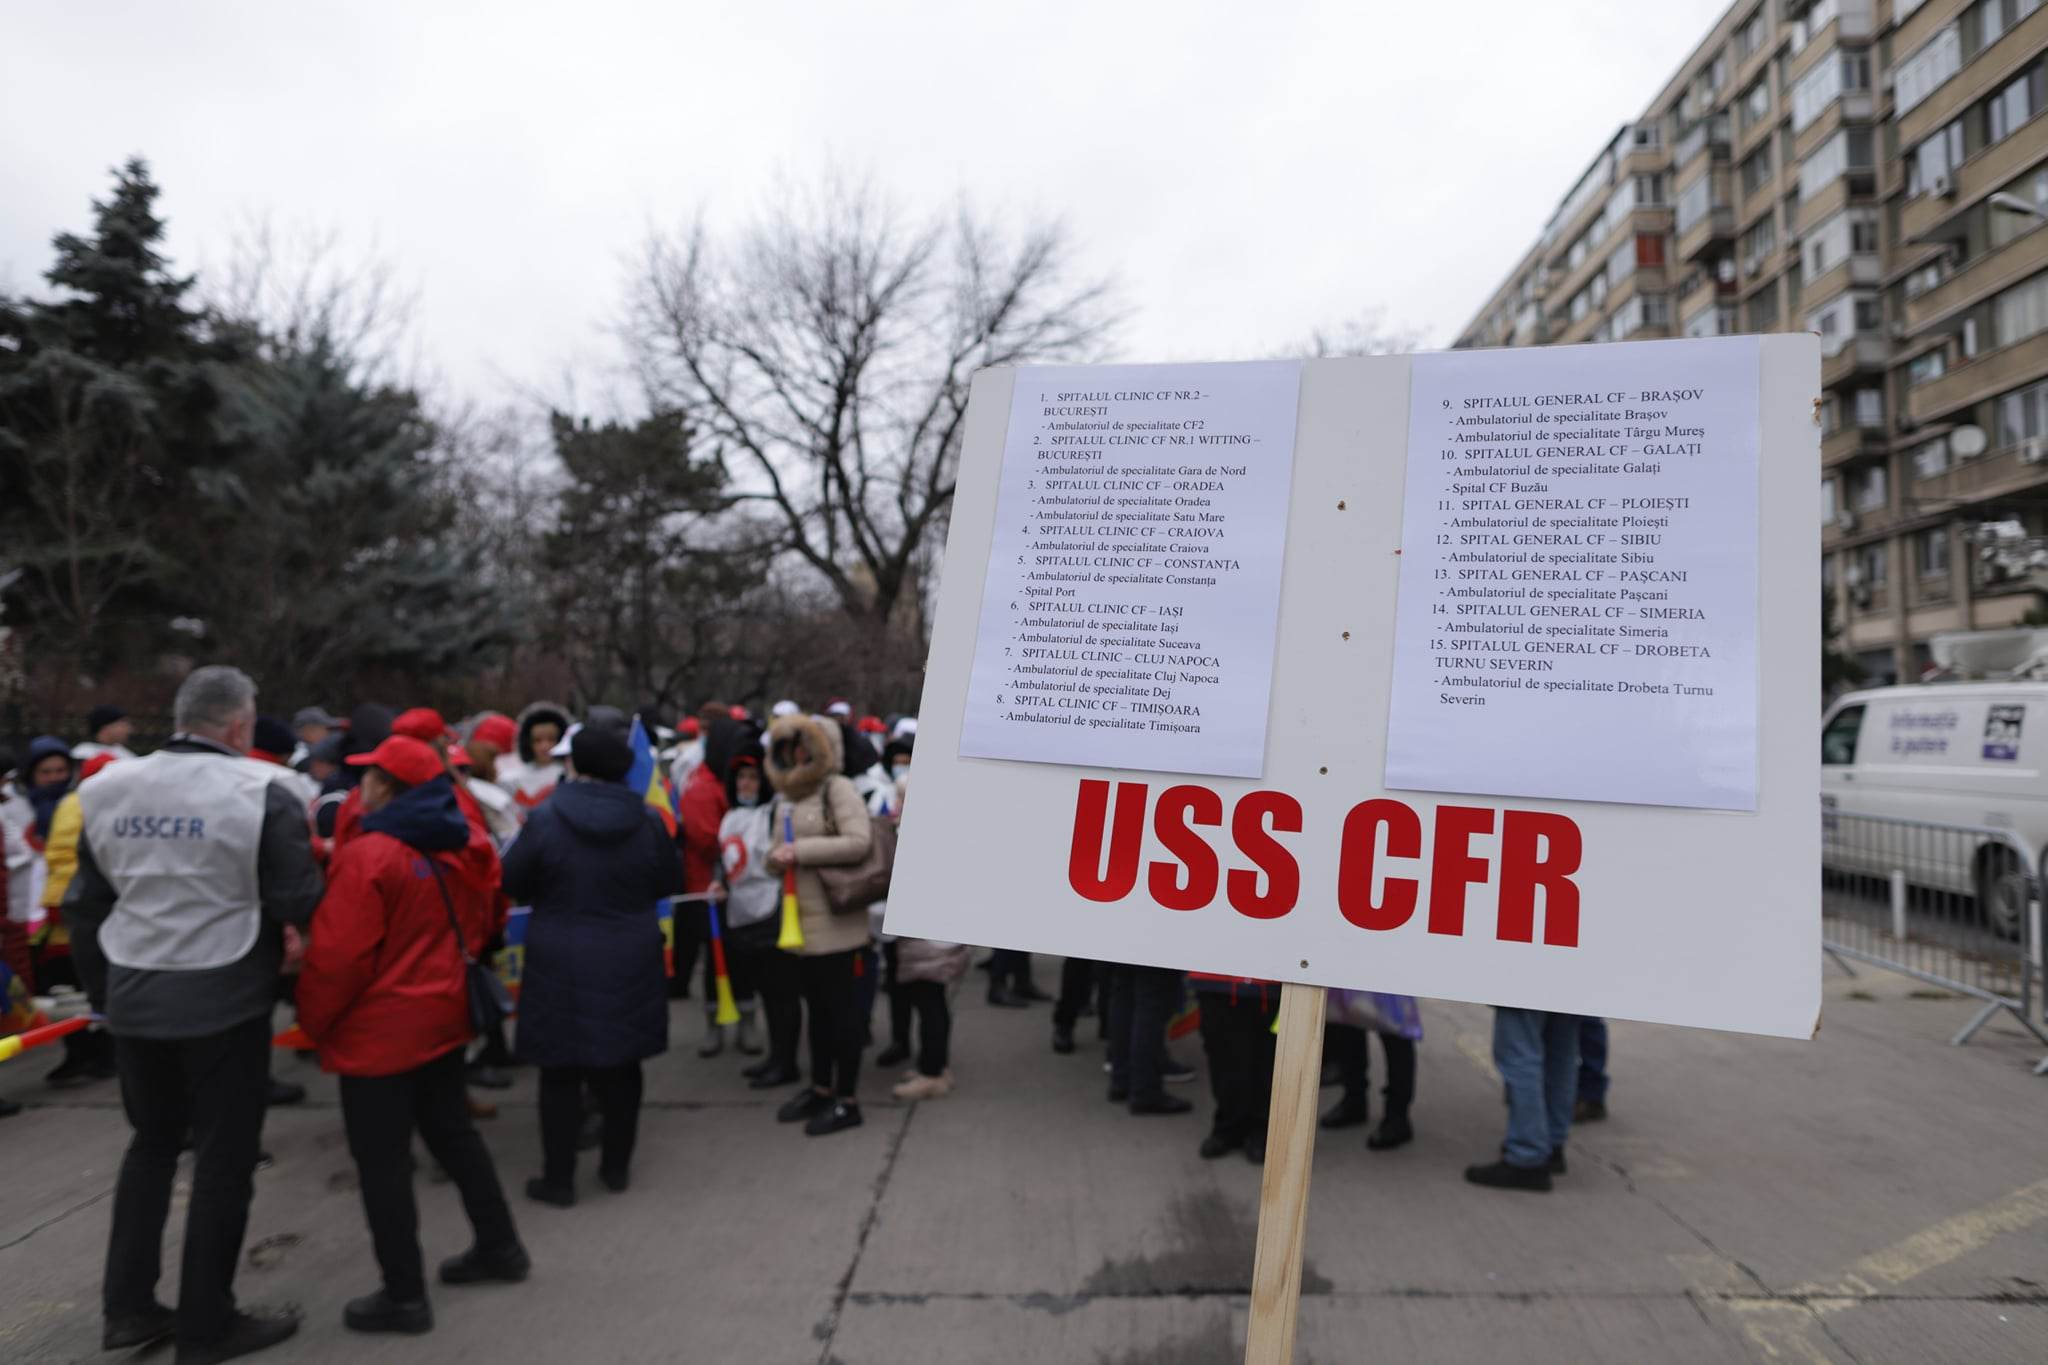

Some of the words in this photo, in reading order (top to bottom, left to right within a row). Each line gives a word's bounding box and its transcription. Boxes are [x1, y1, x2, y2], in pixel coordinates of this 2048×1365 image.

[1056, 392, 1112, 401] SPITALUL
[1114, 391, 1155, 400] CLINIC
[1156, 391, 1172, 400] CF
[1174, 390, 1200, 399] NR.2
[1463, 396, 1531, 408] SPITALUL
[1534, 393, 1604, 406] GENERAL
[1606, 392, 1625, 403] CF
[1456, 413, 1532, 425] Ambulatoriul
[1553, 410, 1620, 425] specialitate
[1047, 421, 1109, 430] Ambulatoriul
[1126, 421, 1181, 431] specialitate
[1182, 420, 1204, 429] CF2
[1050, 435, 1107, 444] SPITALUL
[1108, 435, 1148, 444] CLINIC
[1150, 436, 1167, 444] CF
[1168, 435, 1195, 444] NR.1
[1198, 434, 1251, 444] WITTING
[1455, 430, 1531, 442] Ambulatoriul
[1535, 429, 1550, 440] de
[1552, 427, 1620, 442] specialitate
[1623, 426, 1661, 440] Târgu
[1464, 447, 1533, 459] SPITALUL
[1535, 445, 1606, 457] GENERAL
[1608, 445, 1628, 455] CF
[1041, 465, 1104, 474] Ambulatoriul
[1106, 465, 1118, 474] de
[1121, 465, 1175, 477] specialitate
[1178, 466, 1202, 475] Gara
[1204, 466, 1217, 475] de
[1220, 466, 1246, 475] Nord
[1452, 465, 1530, 476] Ambulatoriul
[1534, 464, 1549, 475] de
[1551, 463, 1620, 477] specialitate
[1044, 480, 1101, 489] SPITALUL
[1102, 480, 1143, 490] CLINIC
[1145, 481, 1161, 490] CF
[1172, 481, 1224, 490] ORADEA
[1452, 482, 1485, 495] Spital
[1488, 482, 1507, 492] CF
[1510, 482, 1548, 492] Buzău
[1037, 495, 1100, 504] Ambulatoriul
[1117, 496, 1172, 507] specialitate
[1174, 496, 1211, 506] Oradea
[1462, 499, 1511, 510] SPITAL
[1514, 499, 1584, 509] GENERAL
[1587, 498, 1607, 509] CF
[1036, 510, 1098, 520] Ambulatoriul
[1101, 511, 1113, 520] de
[1115, 511, 1170, 523] specialitate
[1173, 512, 1195, 521] Satu
[1198, 512, 1224, 521] Mare
[1450, 516, 1529, 527] Ambulatoriul
[1530, 516, 1547, 527] de
[1549, 516, 1619, 529] specialitate
[1039, 525, 1095, 535] SPITALUL
[1097, 526, 1138, 536] CLINIC
[1140, 527, 1156, 536] CF
[1167, 527, 1224, 537] CRAIOVA
[1460, 534, 1509, 544] SPITAL
[1512, 534, 1582, 544] GENERAL
[1586, 534, 1604, 544] CF
[1620, 534, 1661, 544] SIBIU
[1031, 540, 1095, 550] Ambulatoriul
[1112, 542, 1167, 554] specialitate
[1169, 543, 1209, 552] Craiova
[1035, 555, 1091, 566] SPITALUL
[1093, 557, 1134, 567] CLINIC
[1136, 558, 1152, 567] CF
[1448, 551, 1527, 562] Ambulatoriul
[1548, 552, 1617, 565] specialitate
[1620, 552, 1654, 563] Sibiu
[1027, 570, 1090, 581] Ambulatoriul
[1093, 572, 1105, 582] de
[1108, 572, 1163, 585] specialitate
[1458, 569, 1508, 579] SPITAL
[1511, 569, 1582, 580] GENERAL
[1585, 570, 1604, 580] CF
[1025, 586, 1052, 598] Spital
[1055, 587, 1075, 596] Port
[1447, 586, 1525, 597] Ambulatoriul
[1529, 587, 1543, 598] de
[1547, 587, 1616, 601] specialitate
[1028, 601, 1085, 612] SPITALUL
[1087, 603, 1128, 614] CLINIC
[1130, 605, 1147, 614] CF
[1456, 604, 1526, 615] SPITALUL
[1529, 605, 1601, 617] GENERAL
[1604, 606, 1624, 617] CF
[1639, 607, 1706, 619] SIMERIA
[1020, 616, 1084, 628] Ambulatoriul
[1102, 620, 1158, 633] specialitate
[1444, 621, 1523, 633] Ambulatoriul
[1527, 623, 1542, 634] de
[1546, 623, 1615, 638] specialitate
[1619, 625, 1668, 637] Simeria
[1018, 632, 1082, 644] Ambulatoriul
[1084, 635, 1097, 644] de
[1099, 635, 1156, 649] specialitate
[1158, 638, 1201, 649] Suceava
[1450, 639, 1521, 652] SPITALUL
[1524, 641, 1596, 654] GENERAL
[1599, 643, 1619, 654] CF
[1634, 644, 1711, 657] DROBETA
[1022, 647, 1079, 660] SPITALUL
[1080, 650, 1122, 662] CLINIC
[1134, 653, 1165, 664] CLUJ
[1167, 655, 1220, 667] NAPOCA
[1434, 656, 1485, 668] TURNU
[1489, 658, 1553, 670] SEVERIN
[1013, 663, 1078, 676] Ambulatoriul
[1080, 667, 1093, 676] de
[1095, 667, 1151, 682] specialitate
[1154, 670, 1176, 683] Cluj
[1179, 672, 1219, 686] Napoca
[1011, 679, 1075, 691] Ambulatoriul
[1078, 682, 1090, 692] de
[1093, 683, 1149, 698] specialitate
[1153, 687, 1170, 700] Dej
[1441, 674, 1521, 688] Ambulatoriul
[1524, 677, 1540, 689] de
[1543, 678, 1614, 694] specialitate
[1617, 681, 1669, 694] Drobeta
[1672, 683, 1713, 695] Turnu
[1014, 695, 1055, 707] SPITAL
[1058, 697, 1099, 709] CLINIC
[1102, 700, 1118, 711] CF
[1439, 693, 1486, 705] Severin
[1006, 710, 1071, 724] Ambulatoriul
[1073, 715, 1086, 725] de
[1088, 716, 1145, 731] specialitate
[113, 815, 205, 839] USSCFR
[1068, 778, 1303, 920] USS
[1337, 798, 1583, 948] CFR
